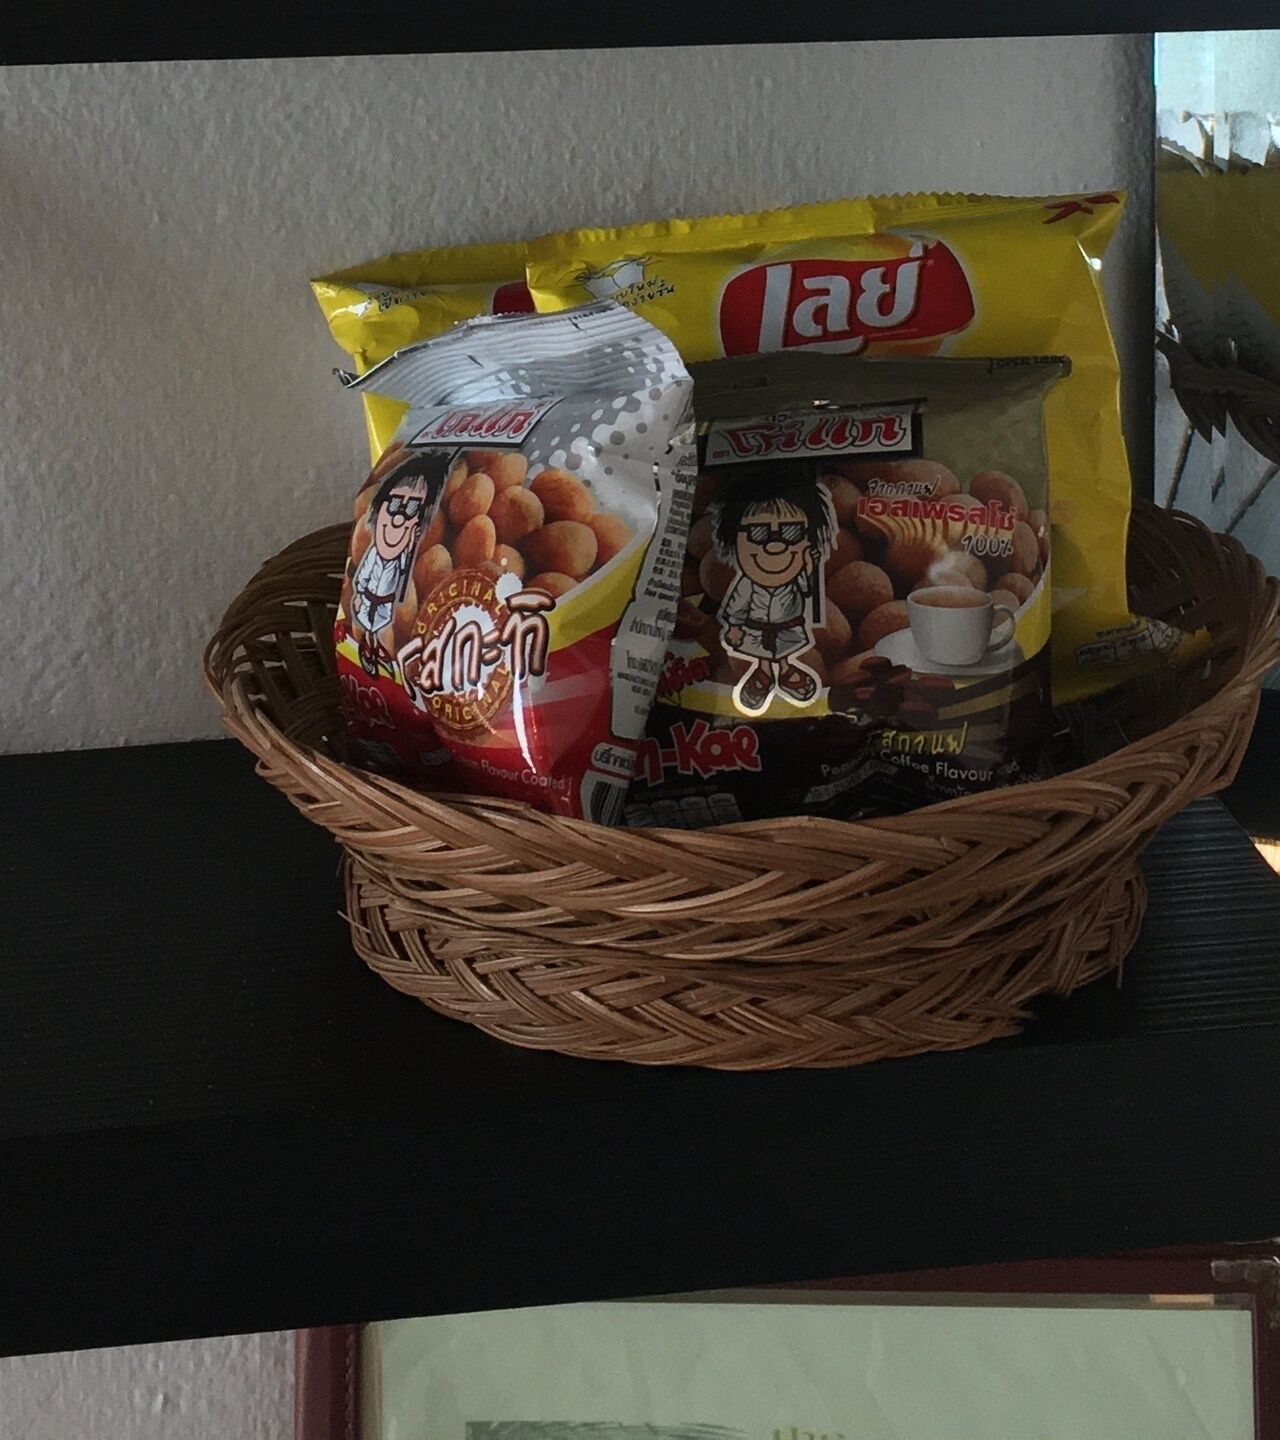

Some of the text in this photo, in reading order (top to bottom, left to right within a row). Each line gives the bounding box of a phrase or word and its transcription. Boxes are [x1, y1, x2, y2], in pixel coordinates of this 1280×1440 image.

[757, 234, 929, 359] เลย์
[961, 534, 1015, 558] 100%
[396, 587, 556, 699] รสกะทิ
[481, 759, 520, 781] Flavour
[521, 768, 566, 790] Coated
[880, 749, 931, 774] Coffee
[935, 760, 994, 782] Flavour
